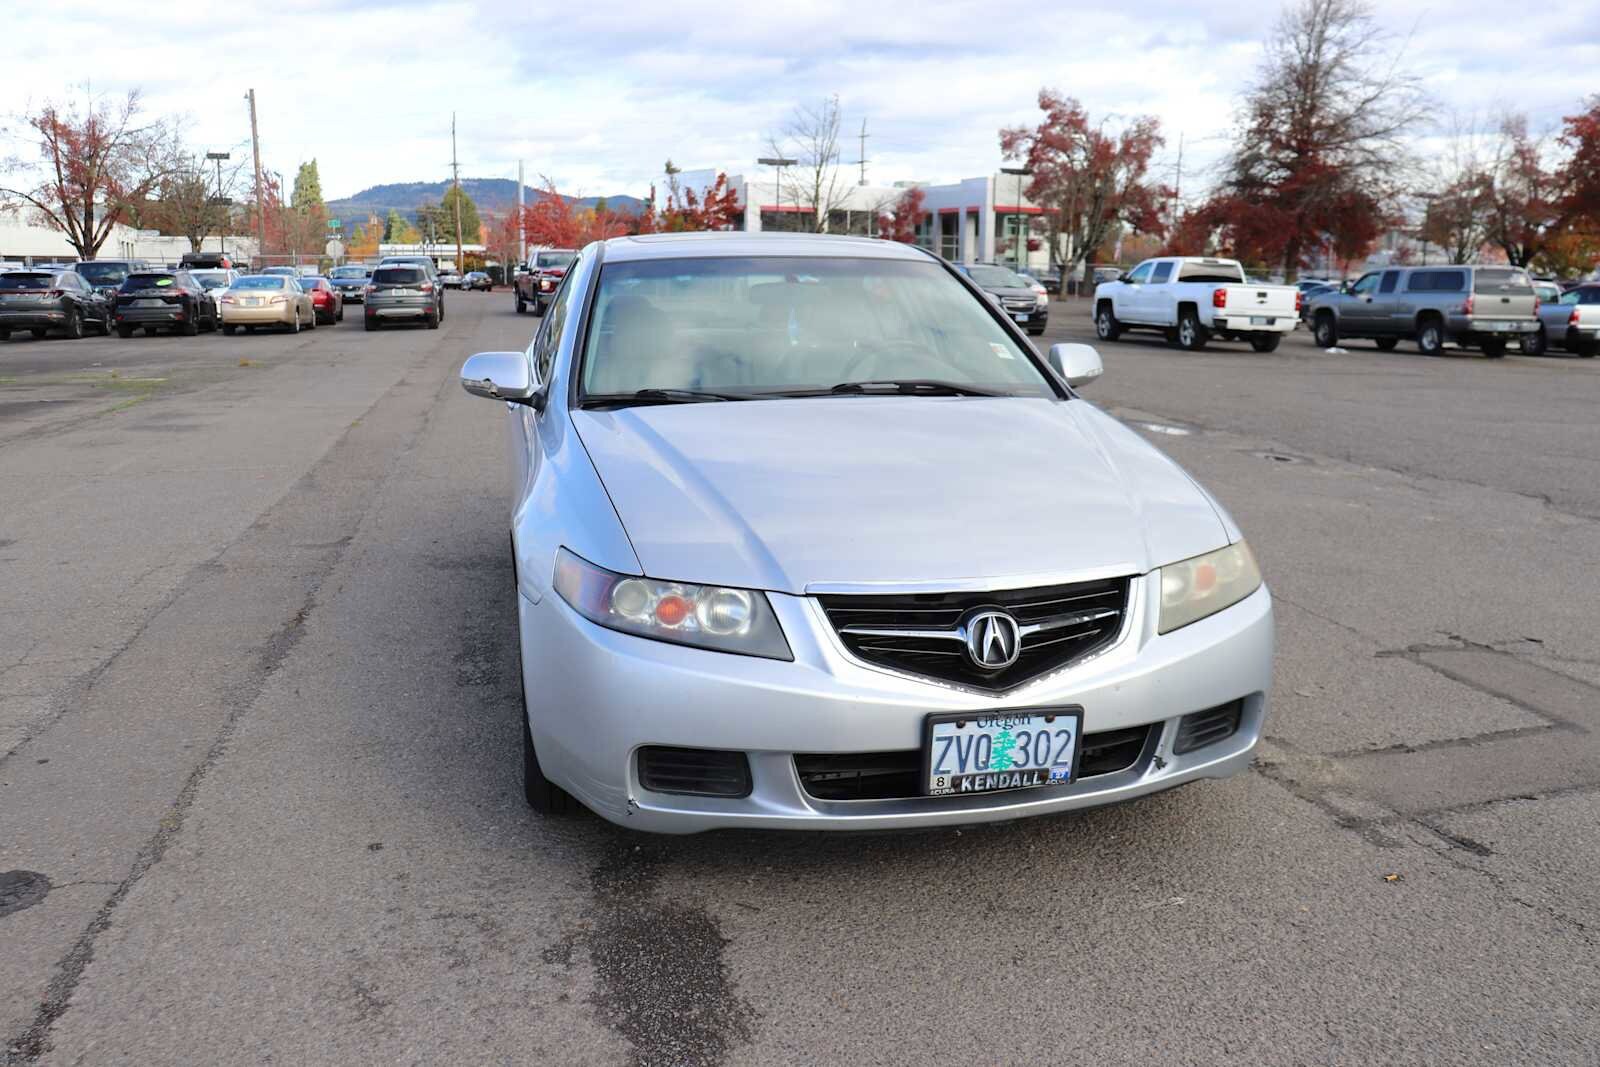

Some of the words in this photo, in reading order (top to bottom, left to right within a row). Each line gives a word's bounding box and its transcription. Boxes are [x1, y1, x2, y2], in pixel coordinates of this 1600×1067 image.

[976, 712, 1031, 730] Oregon
[933, 734, 992, 775] ZVQ
[1013, 729, 1072, 768] 302
[936, 777, 945, 787] 8
[961, 771, 1042, 792] KENDALL
